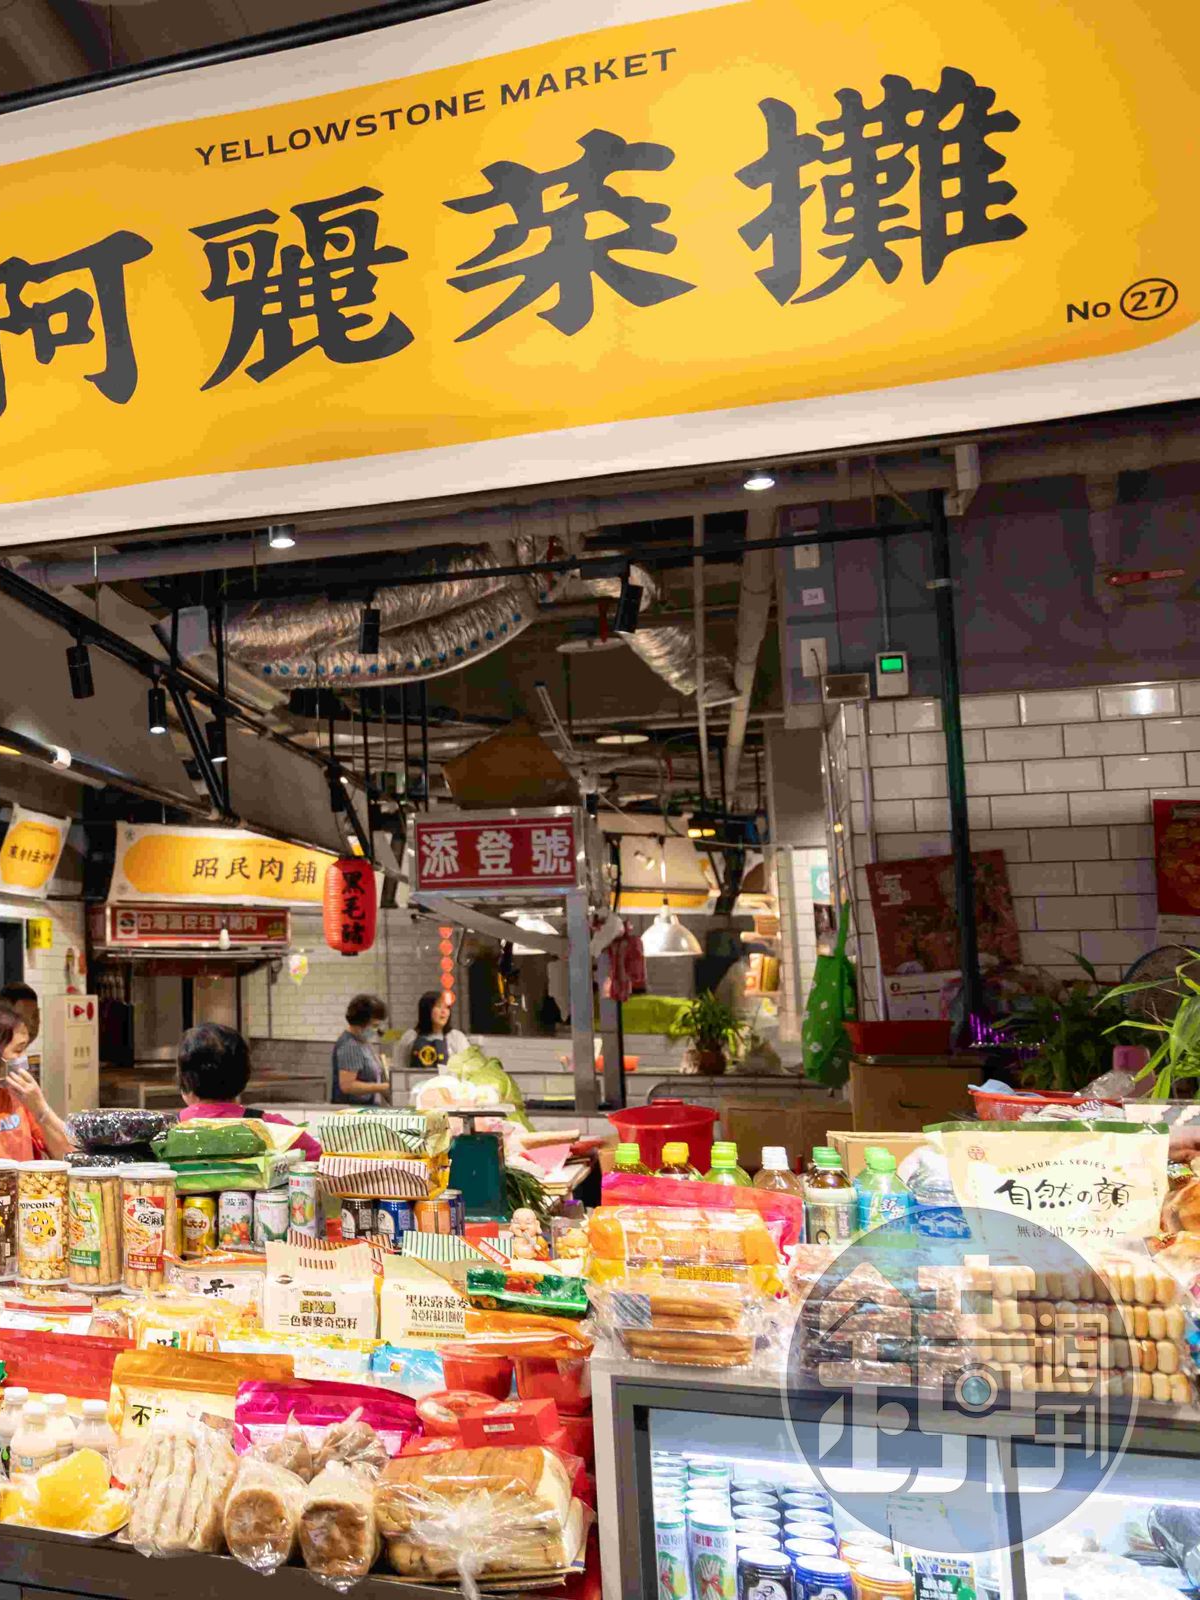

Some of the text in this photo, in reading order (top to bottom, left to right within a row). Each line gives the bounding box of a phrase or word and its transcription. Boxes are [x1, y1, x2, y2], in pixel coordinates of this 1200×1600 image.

[195, 47, 678, 168] YELLOWSTONE MARKET
[1066, 284, 1170, 323] No 27
[420, 828, 572, 879] 添登號
[1016, 1158, 1107, 1174] NATURAL SERIES
[278, 1314, 358, 1330] 三色藜麥奇亞籽
